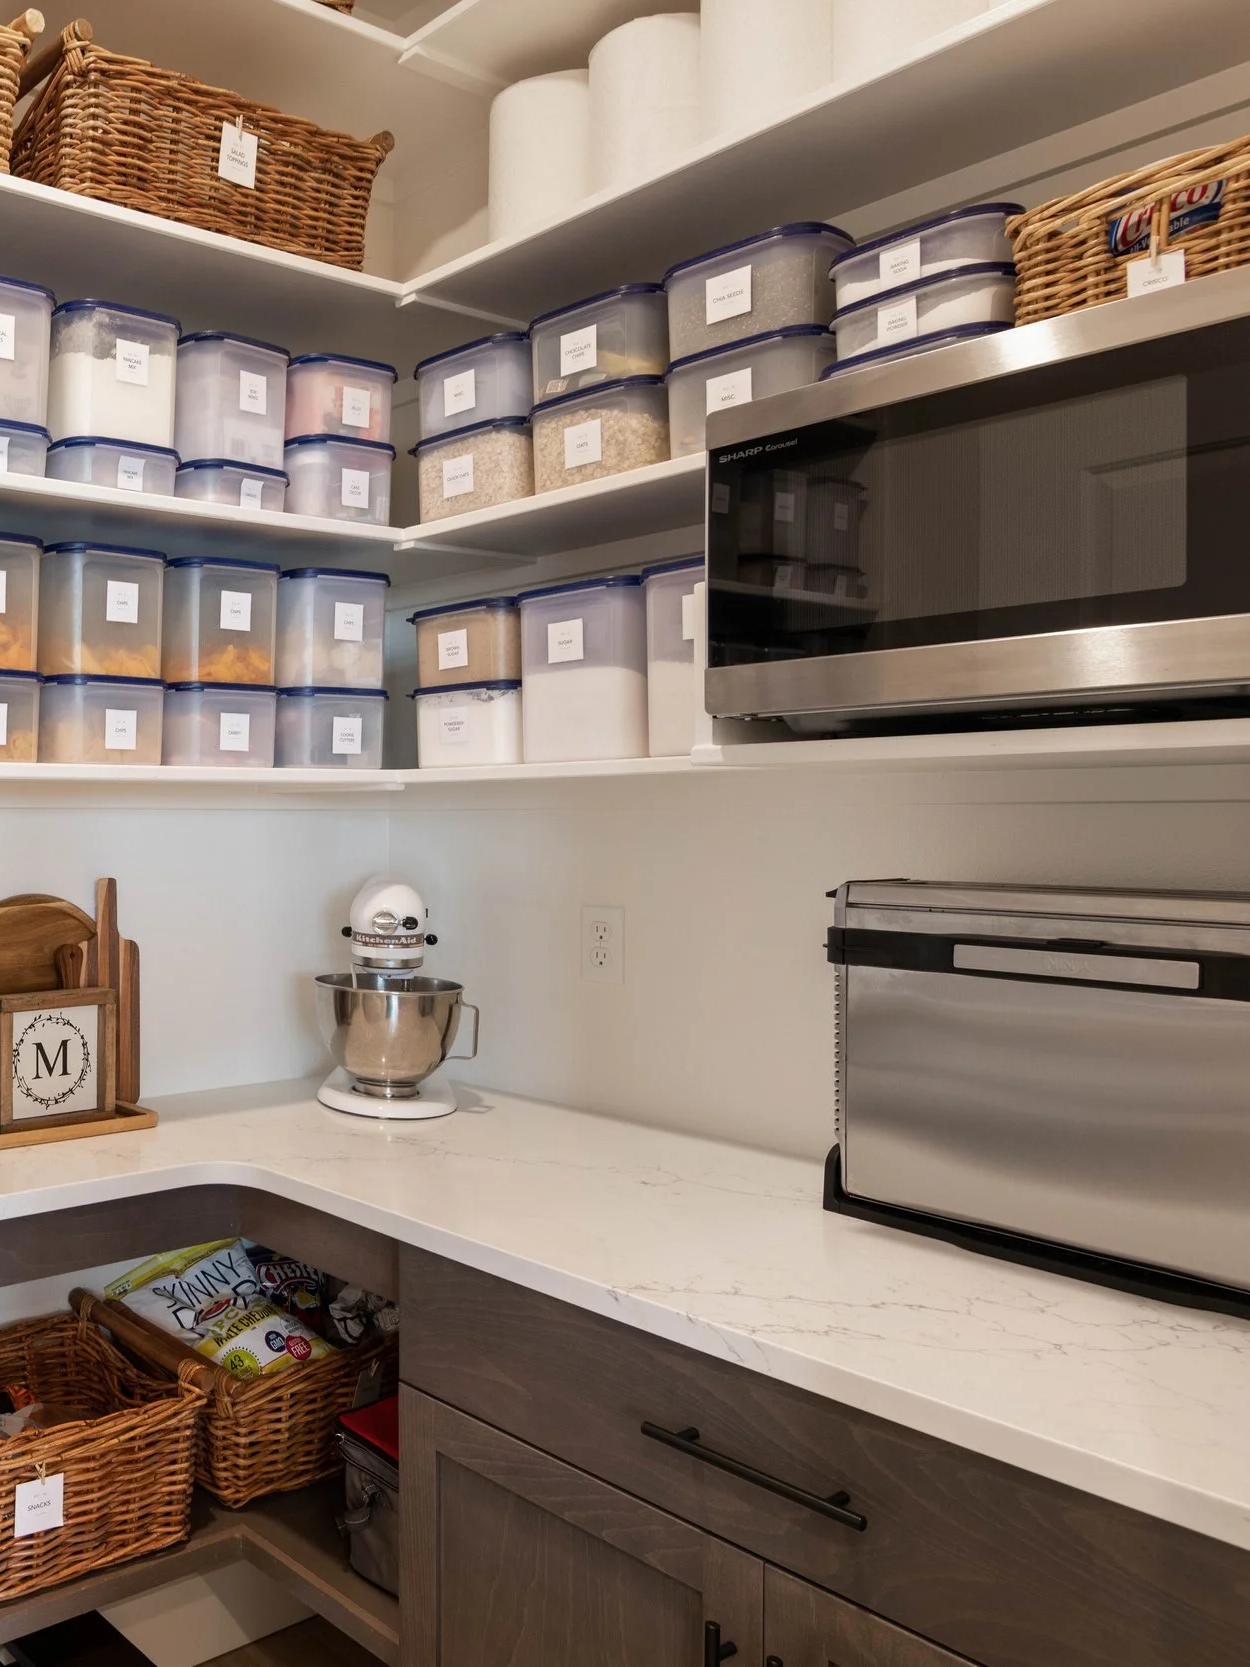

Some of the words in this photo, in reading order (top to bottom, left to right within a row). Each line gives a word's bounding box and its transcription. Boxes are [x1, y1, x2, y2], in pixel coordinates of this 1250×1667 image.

[1142, 276, 1168, 287] CRISCO
[712, 295, 726, 304] CHIA
[726, 289, 744, 299] SEEDS
[564, 343, 591, 356] CHOCOLATE
[571, 352, 586, 361] CHIPS
[576, 441, 589, 449] OATS
[719, 446, 764, 463] SHARP
[765, 438, 798, 453] Carousel
[557, 639, 573, 647] SUGAR
[356, 934, 417, 944] KitchenAid
[32, 1039, 72, 1080] M
[152, 1251, 241, 1309] SKINNY
[269, 1336, 286, 1351] GMO
[291, 1341, 311, 1358] FREE
[230, 1354, 245, 1371] 43
[27, 1499, 52, 1512] SNACKS
